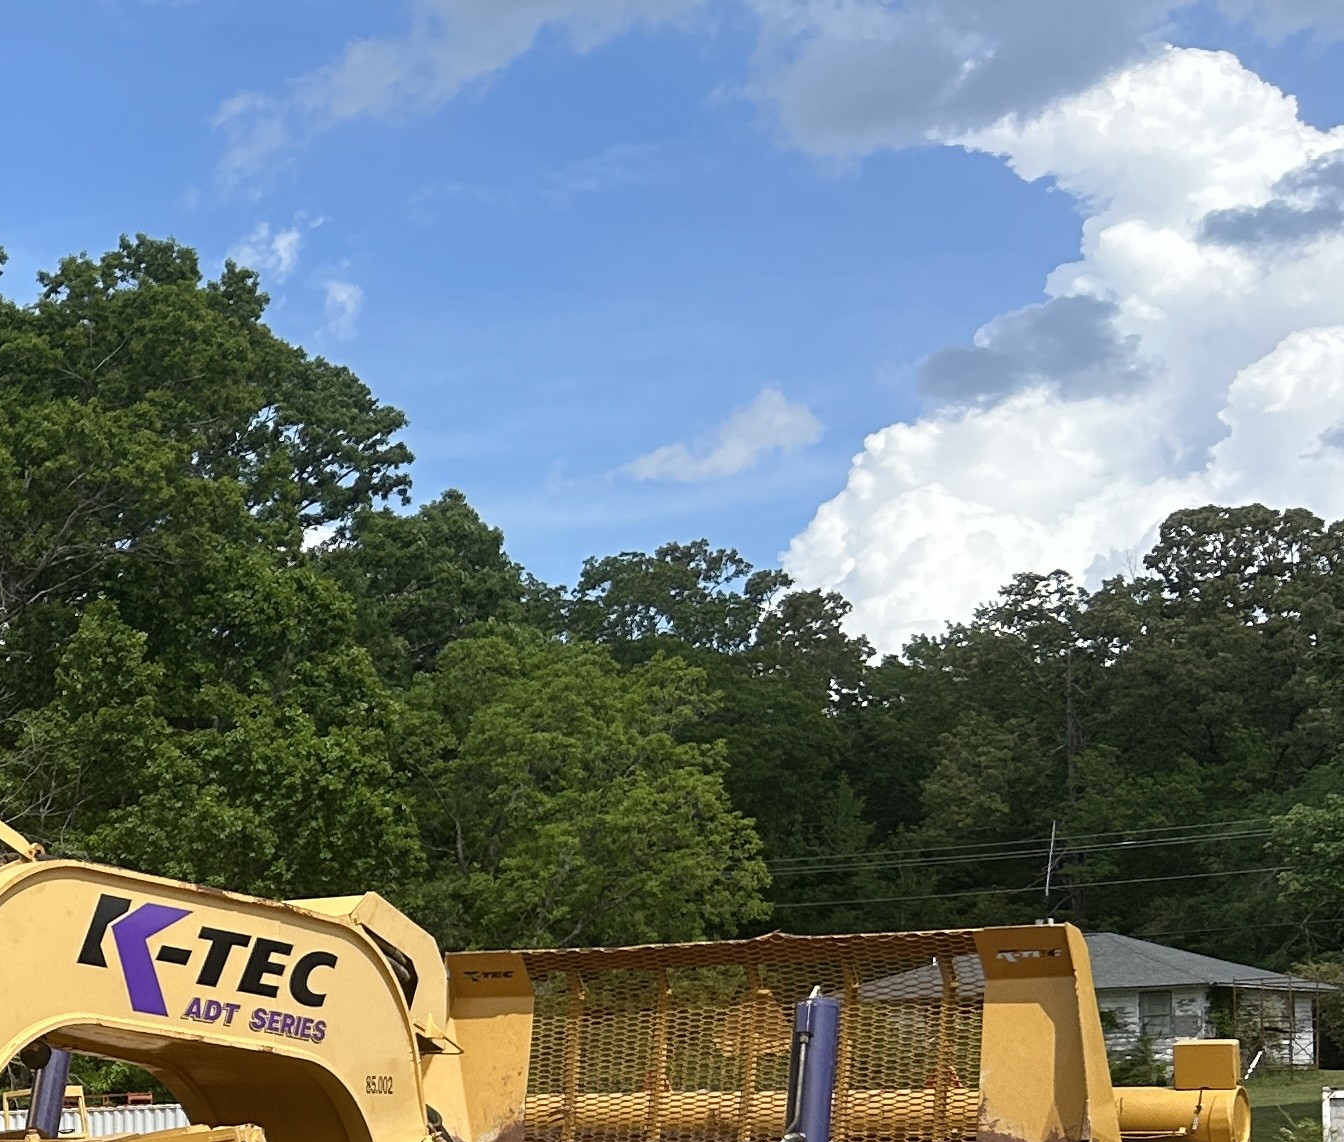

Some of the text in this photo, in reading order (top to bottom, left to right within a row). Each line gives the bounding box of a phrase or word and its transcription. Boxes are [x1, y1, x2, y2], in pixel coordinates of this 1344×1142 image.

[77, 893, 339, 1017] K-TEC
[180, 997, 328, 1045] ADT SERIES
[365, 1075, 394, 1095] 85.002
